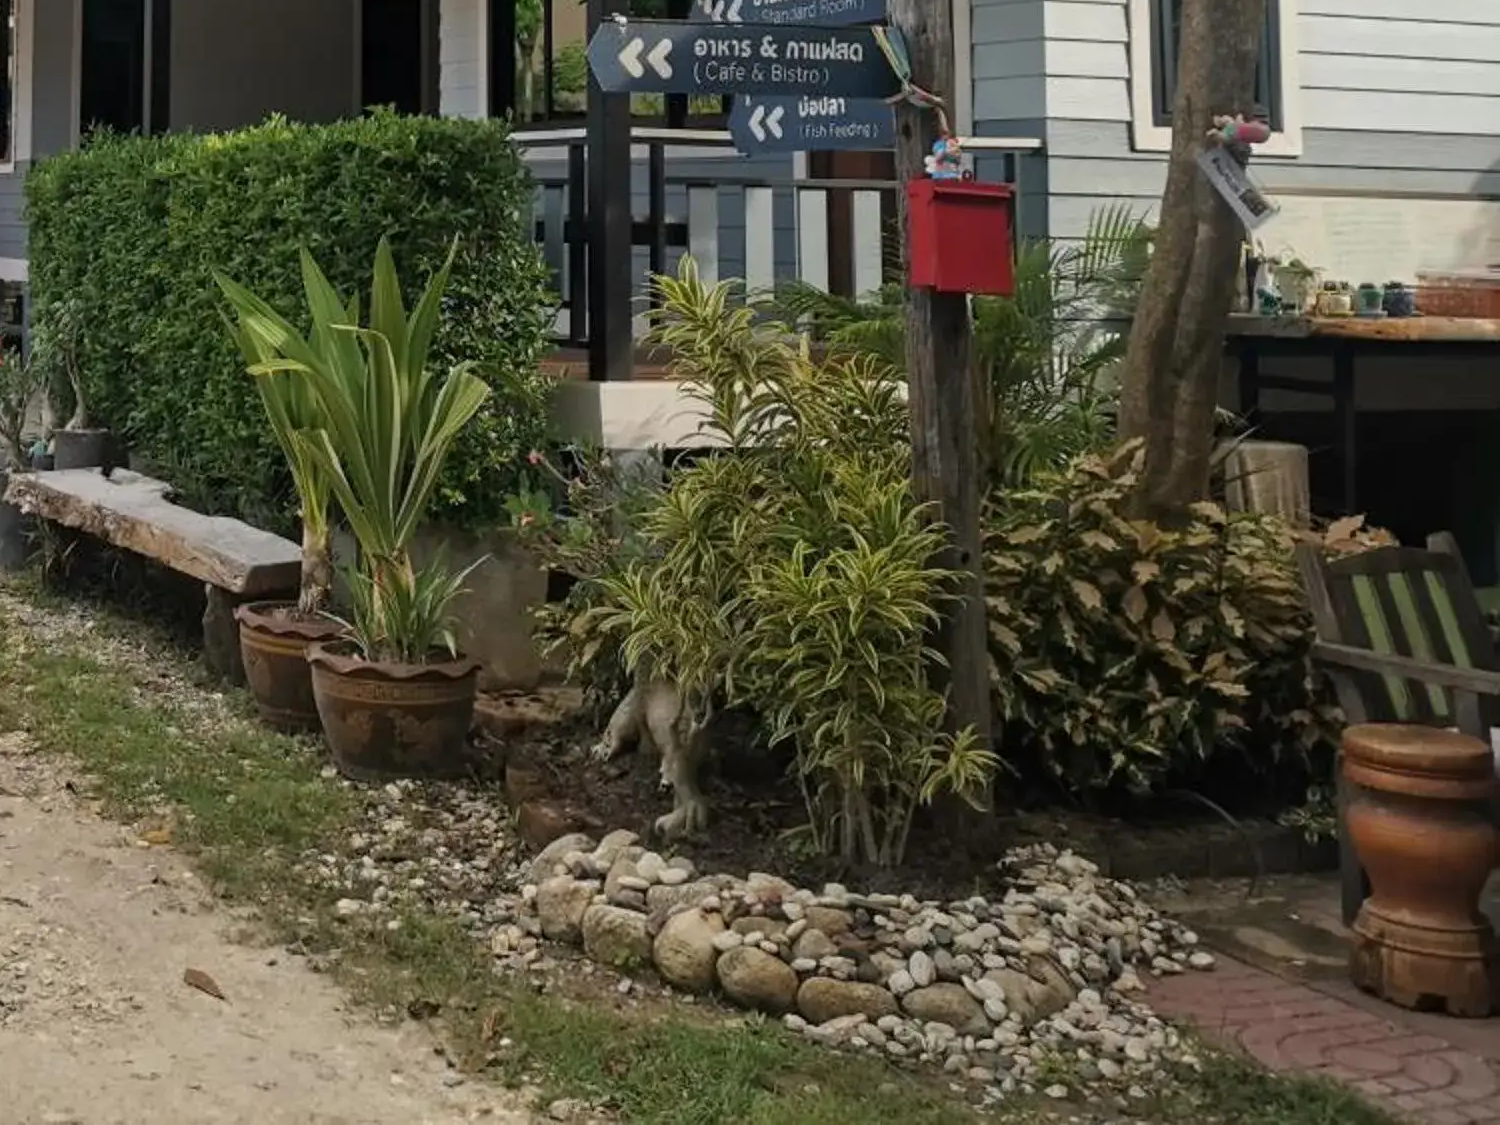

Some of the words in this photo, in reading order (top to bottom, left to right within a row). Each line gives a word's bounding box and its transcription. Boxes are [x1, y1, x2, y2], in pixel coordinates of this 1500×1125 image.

[694, 36, 752, 59] อาหาร
[760, 35, 779, 59] &
[786, 36, 864, 63] กาแฟสด
[751, 62, 766, 82] &
